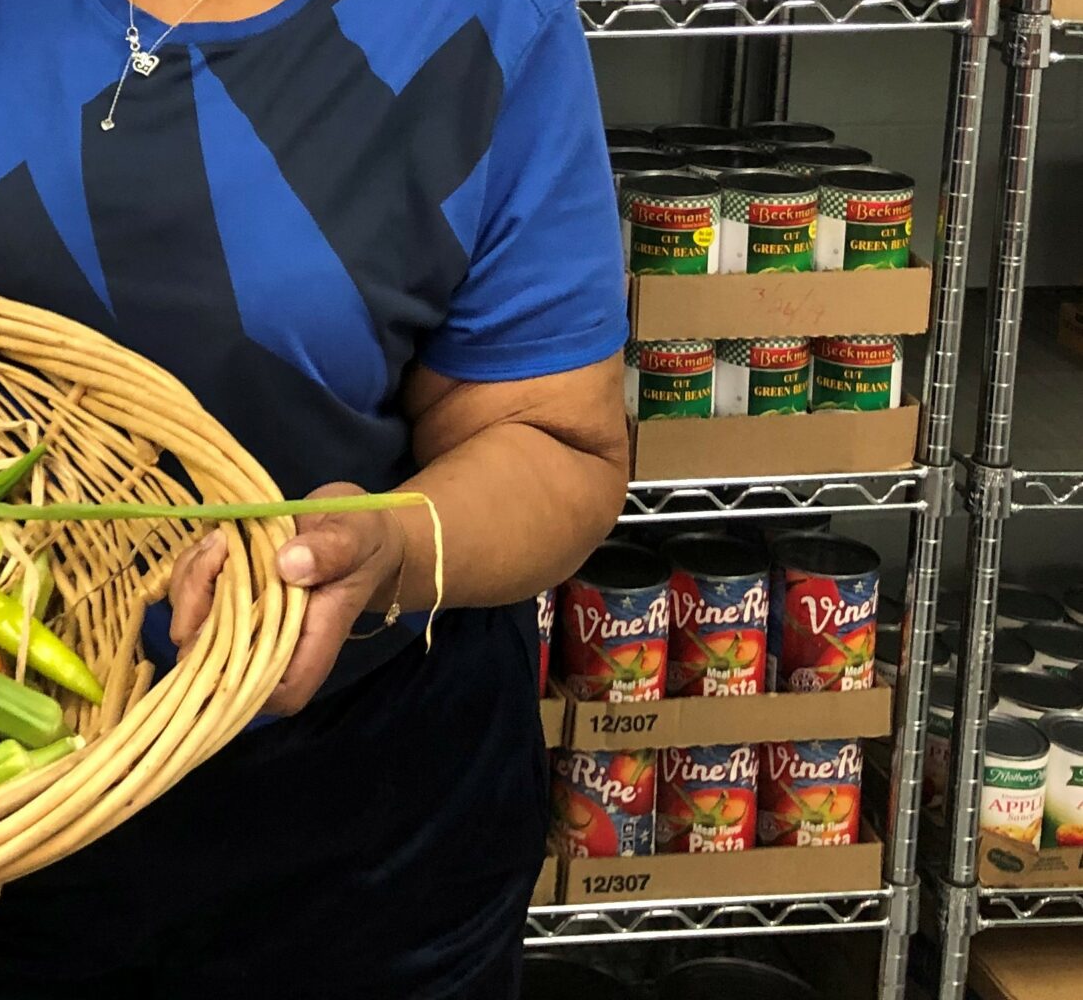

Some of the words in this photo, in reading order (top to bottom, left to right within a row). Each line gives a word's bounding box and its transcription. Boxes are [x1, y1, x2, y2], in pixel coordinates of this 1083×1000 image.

[637, 207, 709, 224] Beckmans
[660, 234, 680, 245] CUT
[783, 231, 800, 241] CUT
[881, 228, 897, 238] CUT
[633, 242, 669, 257] GREEN
[672, 243, 708, 258] BEANS
[752, 242, 792, 255] GREEN
[850, 239, 890, 251] GREEN
[821, 341, 892, 360] Beckmans
[648, 353, 712, 371] Beckmans
[783, 373, 798, 384] CUT
[843, 369, 863, 380] CUT
[673, 379, 691, 389] CUT
[753, 385, 791, 397] GREEN
[816, 377, 852, 391] GREEN
[855, 381, 889, 394] BEANS
[643, 388, 681, 402] GREEN
[669, 588, 742, 629] Vine
[801, 594, 869, 636] Vine
[572, 603, 646, 644] Vine
[706, 667, 730, 679] Meat
[703, 678, 757, 697] Pasta
[590, 714, 659, 734] 12/307
[572, 752, 643, 804] Ripe
[692, 822, 716, 836] Meat
[689, 832, 745, 853] Pasta
[796, 829, 851, 848] Pasta
[582, 874, 651, 894] 12/307
